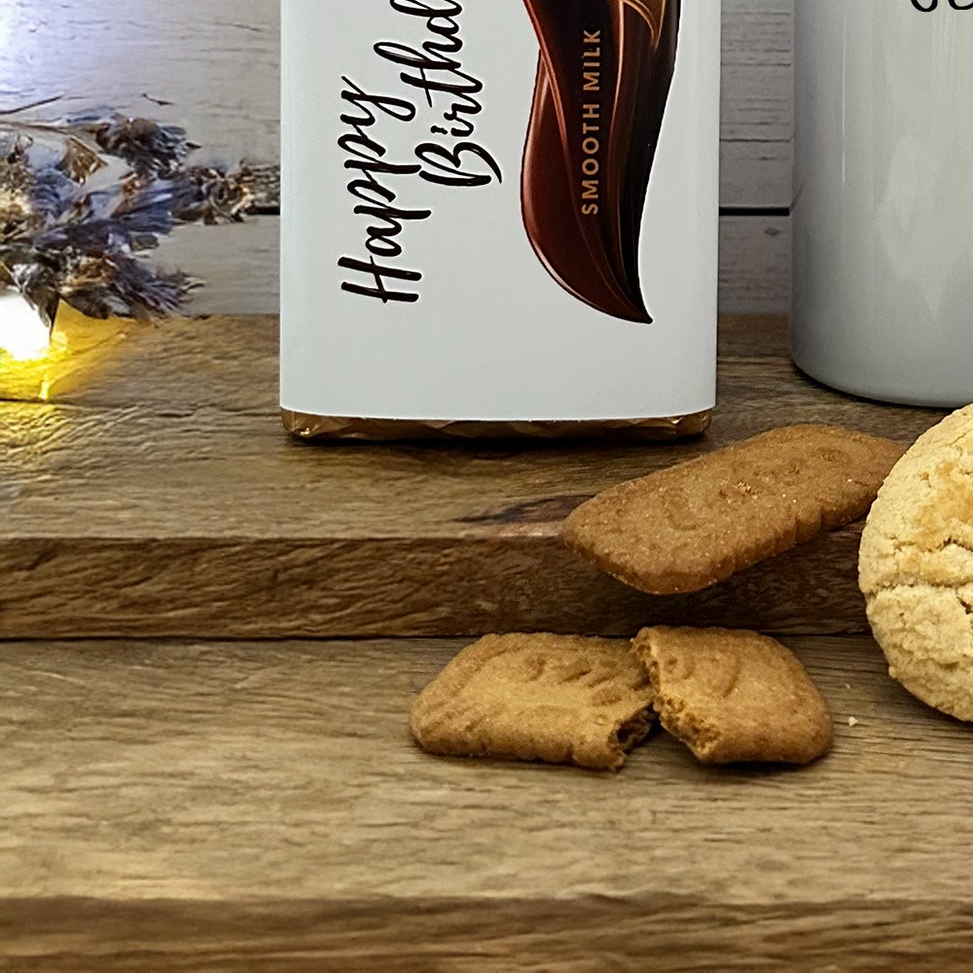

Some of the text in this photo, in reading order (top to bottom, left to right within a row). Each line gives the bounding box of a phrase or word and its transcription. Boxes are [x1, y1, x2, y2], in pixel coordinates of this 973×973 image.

[337, 75, 432, 304] Happy
[581, 29, 601, 216] SMOOTH MILK
